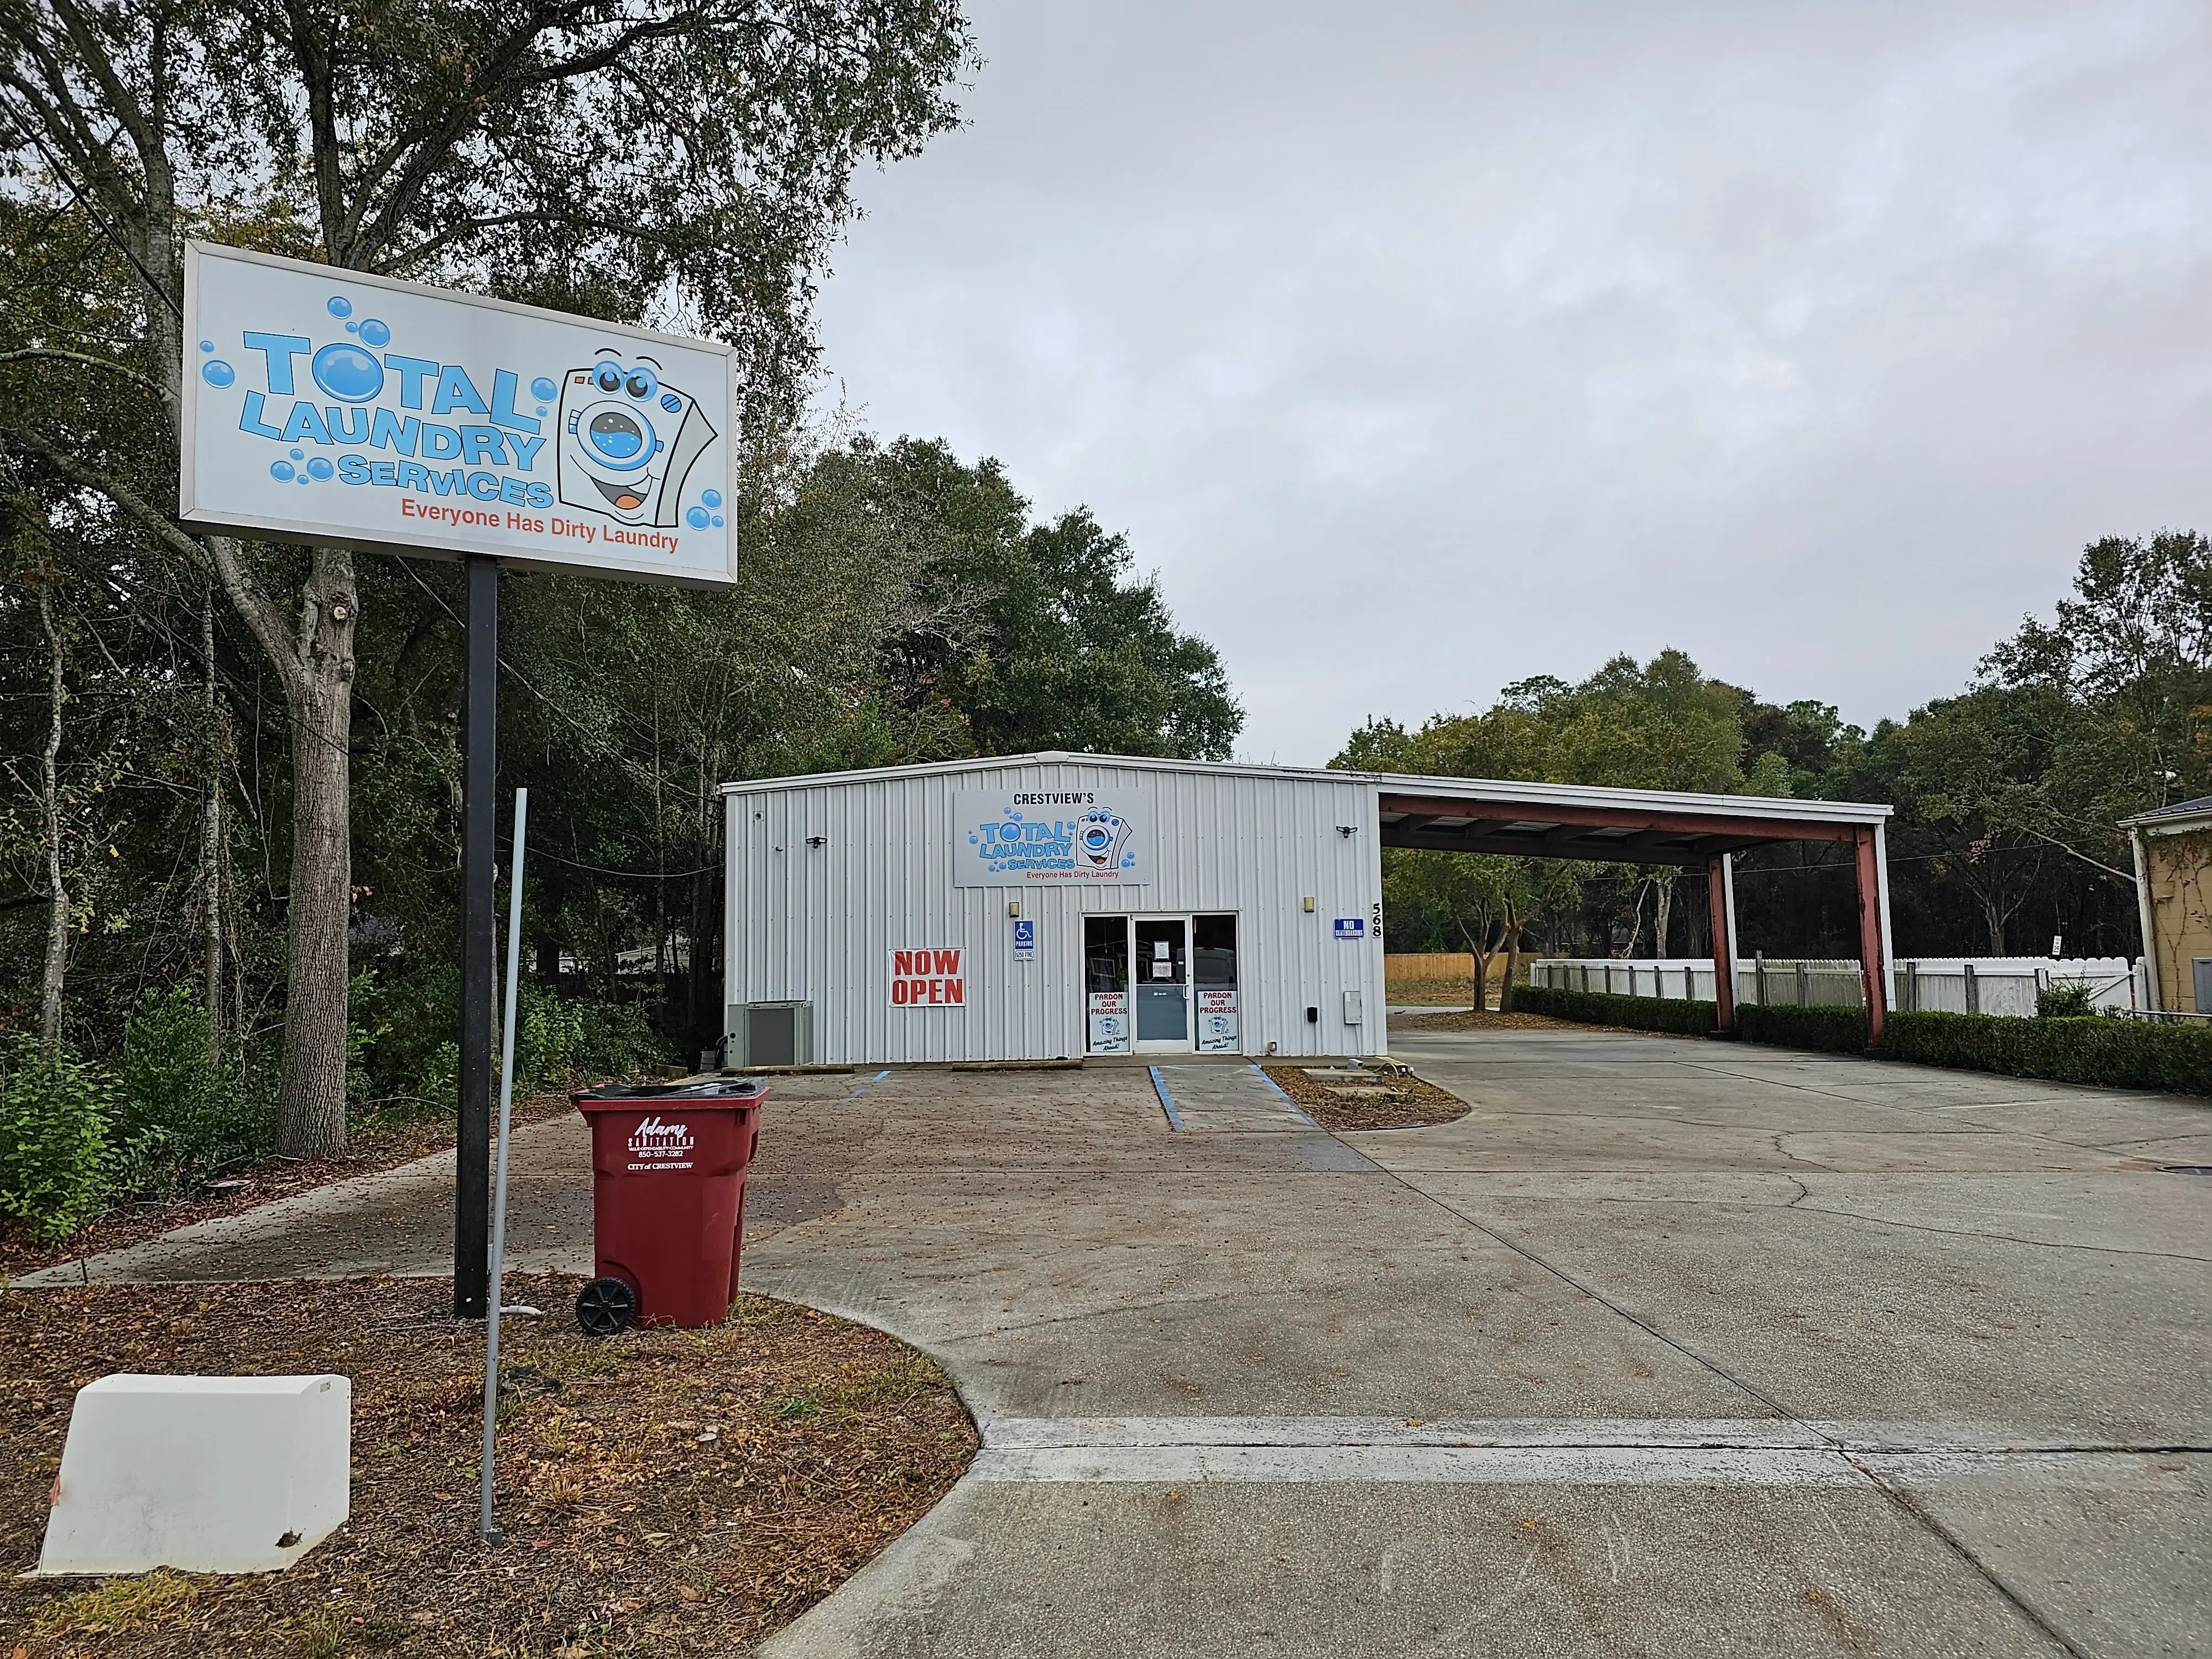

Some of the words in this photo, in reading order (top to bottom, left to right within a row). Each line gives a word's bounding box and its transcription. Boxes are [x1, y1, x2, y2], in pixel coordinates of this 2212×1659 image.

[243, 331, 541, 435] TOTAL
[239, 390, 547, 471] LAUNDRY
[338, 455, 554, 509] SERVICES
[402, 498, 500, 526] Everyone
[507, 512, 544, 533] Has
[551, 517, 596, 544] Dirty
[603, 523, 679, 554] Laundry
[1014, 792, 1094, 805] CRESTVIEW'S
[979, 821, 1071, 843] TOTAL
[979, 842, 1073, 859] LAUNDRY
[1007, 858, 1075, 870] SERVICES
[1343, 920, 1354, 930] NO
[1373, 903, 1381, 936] 568
[895, 950, 961, 975] NOW
[892, 978, 963, 1004] OPEN
[634, 1117, 688, 1138] Adams
[628, 1136, 694, 1147] SANITATION
